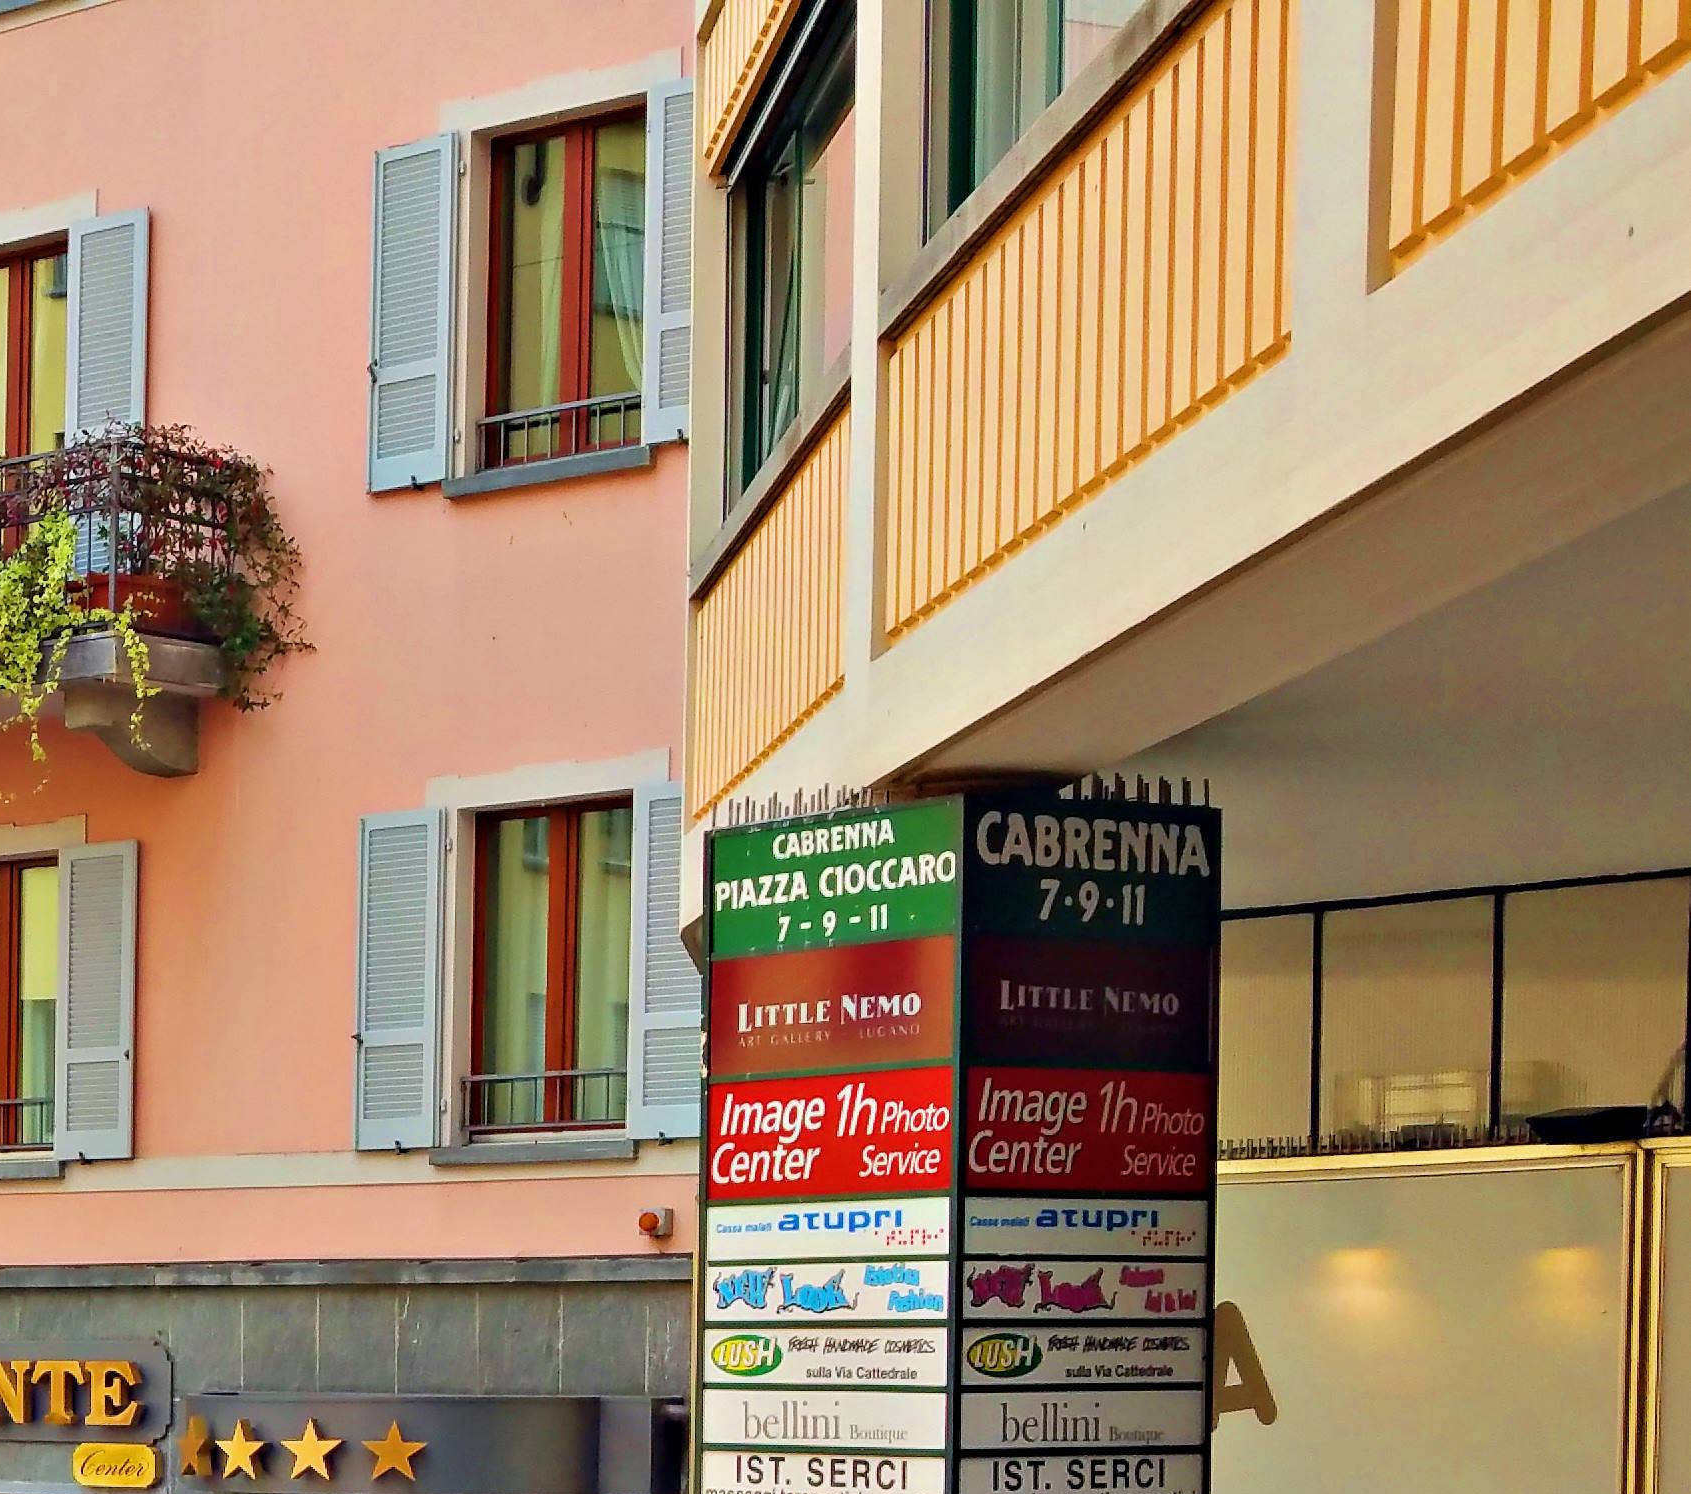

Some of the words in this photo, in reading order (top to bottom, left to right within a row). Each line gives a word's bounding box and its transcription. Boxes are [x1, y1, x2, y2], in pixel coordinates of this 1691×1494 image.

[772, 816, 896, 860] CABRENNA
[976, 810, 1211, 878] CABRENNA
[715, 872, 810, 912] PIAZZA
[819, 850, 957, 897] CIOCCARO
[736, 999, 831, 1034] LITTLE
[840, 992, 922, 1024] NEMO
[1000, 979, 1094, 1011] LITTLE
[1103, 985, 1180, 1016] NEMO
[718, 1093, 825, 1145] Image
[836, 1083, 878, 1138] 1h
[881, 1100, 951, 1135] Photo
[978, 1077, 1087, 1131] Image
[1099, 1080, 1138, 1134] 1h
[1142, 1101, 1205, 1137] Photo
[712, 1142, 821, 1185] Center
[859, 1144, 942, 1178] Service
[969, 1128, 1083, 1175] Center
[1121, 1143, 1197, 1177] Service
[778, 1209, 903, 1232] atupri
[1035, 1209, 1159, 1231] atupri
[716, 1336, 777, 1369] LUSH
[973, 1335, 1038, 1369] LUSH
[1094, 1365, 1112, 1378] Via
[806, 1366, 832, 1379] sulla
[835, 1366, 853, 1380] Via
[856, 1367, 918, 1380] Cattedrale
[742, 1400, 841, 1441] bellini
[849, 1424, 909, 1444] Boutique
[1000, 1401, 1101, 1443] bellini
[79, 1448, 152, 1480] Center
[736, 1454, 792, 1486] IST.
[806, 1457, 909, 1491] SERCI
[992, 1459, 1052, 1491] IST.
[1066, 1457, 1166, 1491] SERCI
